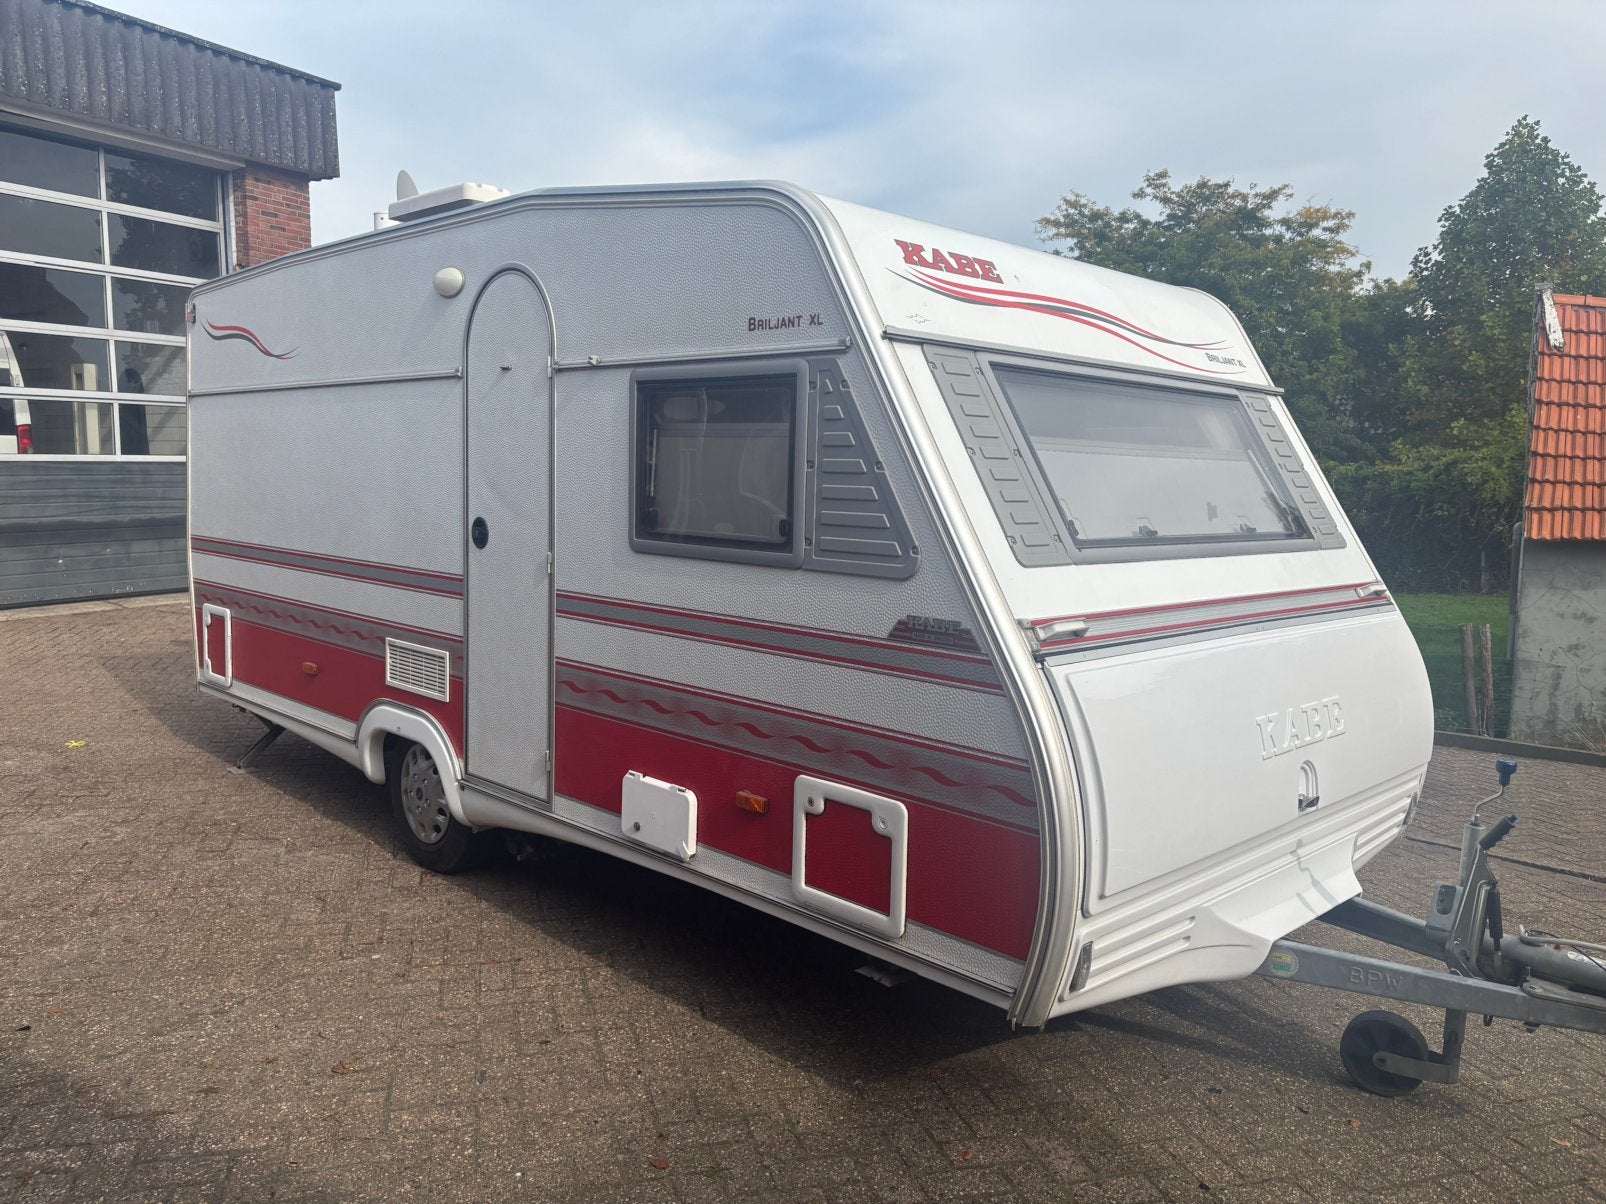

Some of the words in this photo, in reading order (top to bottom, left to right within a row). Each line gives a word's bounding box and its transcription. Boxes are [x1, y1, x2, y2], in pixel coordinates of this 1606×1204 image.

[893, 239, 1004, 284] KABE
[748, 316, 802, 331] BRILJANT
[809, 313, 823, 326] XL
[906, 615, 961, 634] KABE
[1255, 695, 1346, 761] KABE
[1350, 966, 1404, 992] BPW
